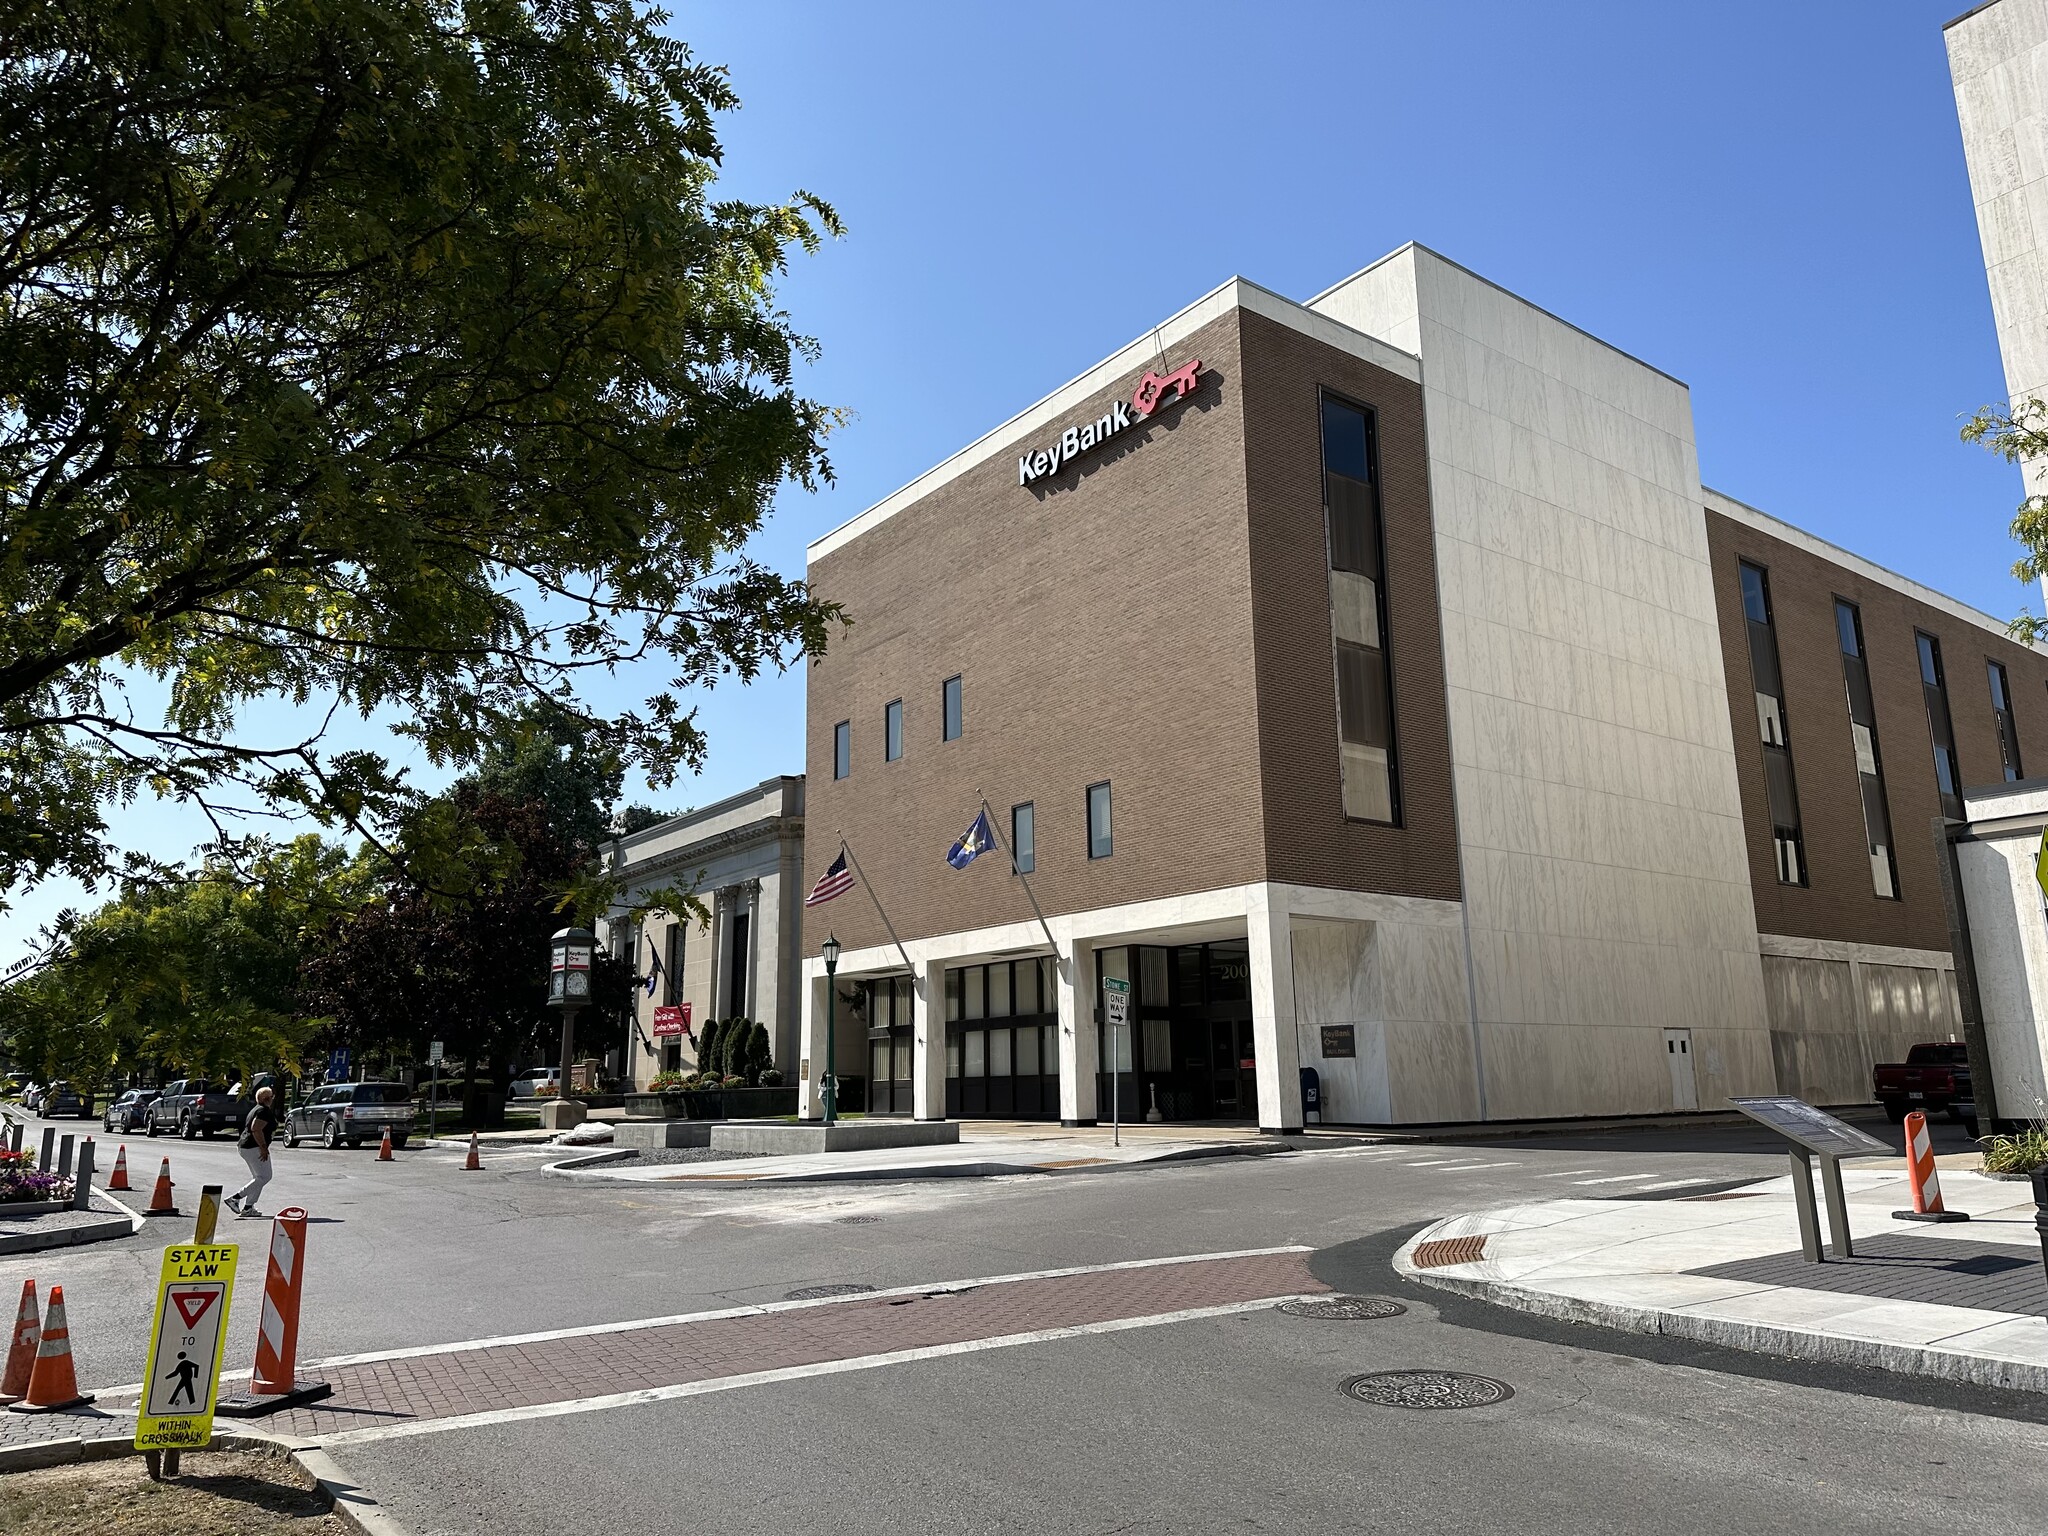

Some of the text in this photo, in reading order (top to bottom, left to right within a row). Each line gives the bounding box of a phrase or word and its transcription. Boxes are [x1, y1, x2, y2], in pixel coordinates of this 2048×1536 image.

[1018, 400, 1131, 486] KeyBank
[1221, 964, 1248, 980] 200
[1110, 994, 1125, 1005] ONE
[1110, 1003, 1125, 1013] WAY
[1323, 1029, 1351, 1039] KeyBank
[334, 1051, 347, 1064] H
[170, 1249, 232, 1263] STATE
[178, 1265, 219, 1278] LAW
[181, 1336, 196, 1346] TO
[158, 1420, 192, 1431] WITHIN
[141, 1430, 204, 1445] CROSSWALK
